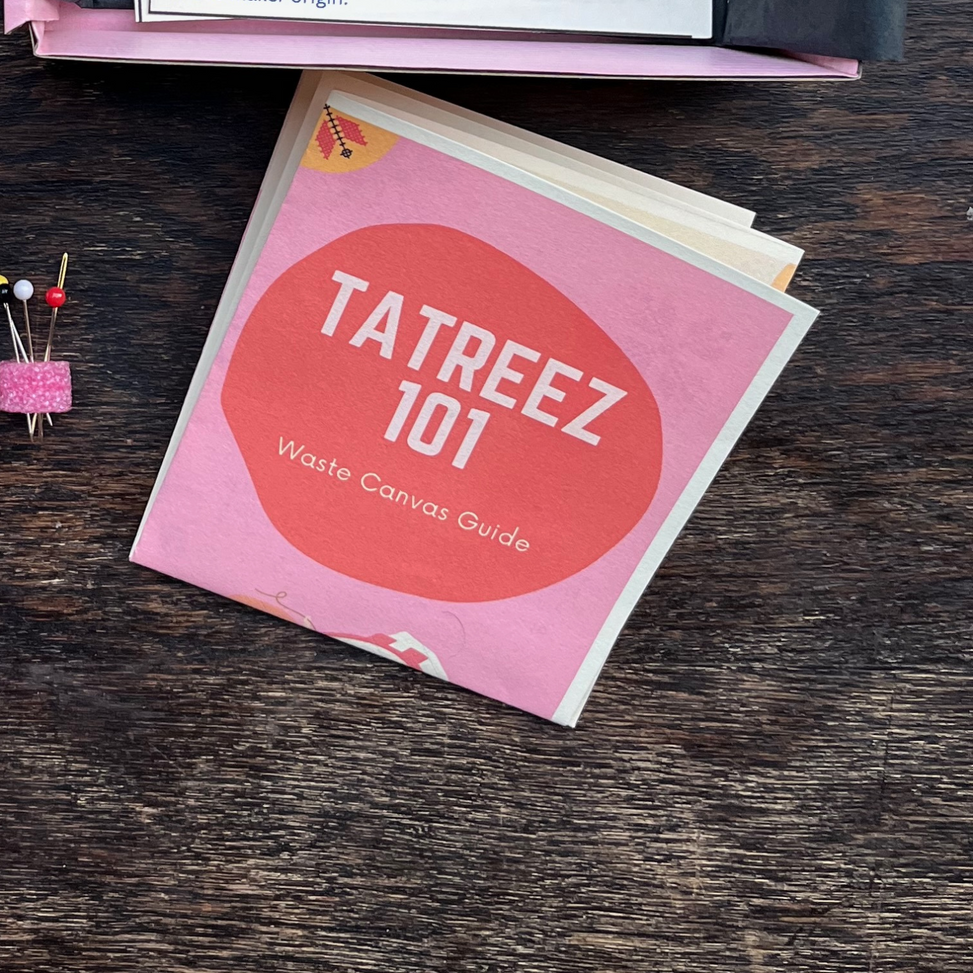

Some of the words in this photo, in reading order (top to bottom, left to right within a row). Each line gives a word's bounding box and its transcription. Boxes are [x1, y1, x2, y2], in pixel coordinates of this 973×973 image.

[320, 269, 628, 447] TATREEZ
[383, 379, 491, 470] 101
[277, 435, 352, 482] Waste
[360, 472, 449, 522] Canvas
[457, 511, 531, 553] Guide
